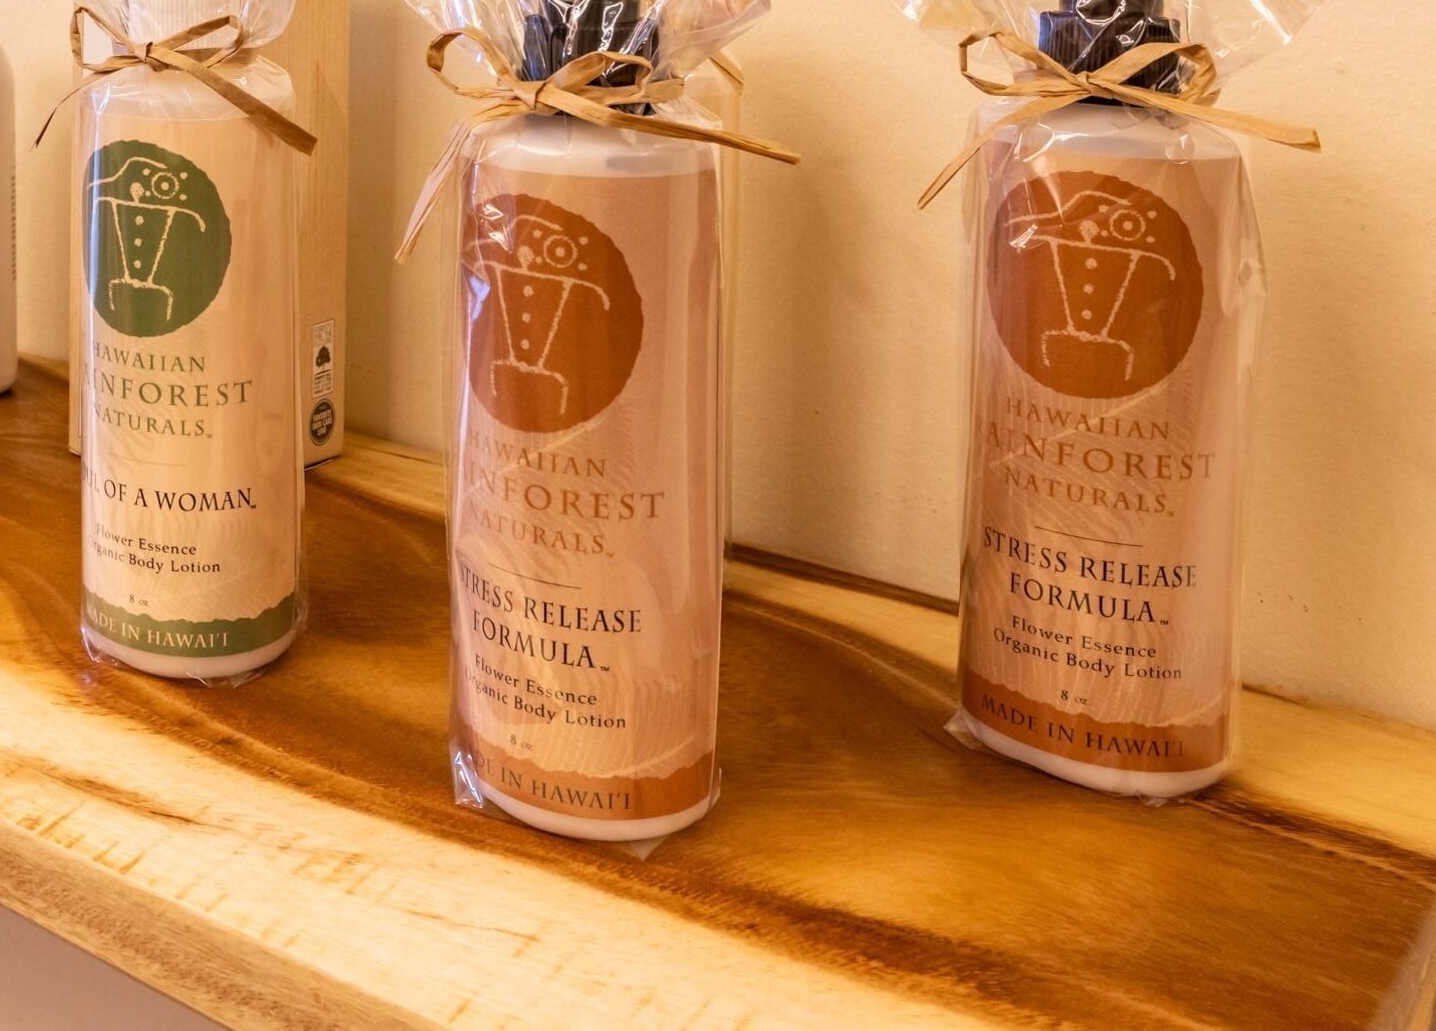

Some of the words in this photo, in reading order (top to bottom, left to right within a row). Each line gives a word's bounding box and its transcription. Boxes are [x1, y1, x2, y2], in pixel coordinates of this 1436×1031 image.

[94, 342, 205, 373] HAWAIIAN
[1007, 397, 1169, 441] HAWAIIAN
[469, 429, 606, 478] HAWAIIAN
[104, 478, 127, 502] OF
[134, 488, 148, 508] A
[96, 523, 133, 547] Flower
[139, 538, 197, 555] Essence
[129, 553, 164, 574] Body
[171, 561, 221, 573] Lotion
[984, 525, 1067, 573] STRESS
[1080, 556, 1196, 590] RELEASE
[460, 562, 514, 613] STRESS
[525, 596, 641, 633] RELEASE
[121, 622, 140, 641] IN
[1012, 615, 1073, 645] Flower
[1082, 635, 1157, 658] Essence
[994, 628, 1058, 663] Organic
[1066, 653, 1115, 678] Body
[1124, 663, 1182, 679] Lotion
[475, 654, 520, 688] Flower
[526, 679, 597, 706] Essence
[1061, 689, 1068, 701] 8
[514, 697, 556, 724] Body
[565, 710, 626, 728] Lotion
[982, 694, 1038, 731] MADE
[1048, 722, 1074, 744] IN
[510, 735, 517, 746] 8
[501, 766, 522, 789] IN
